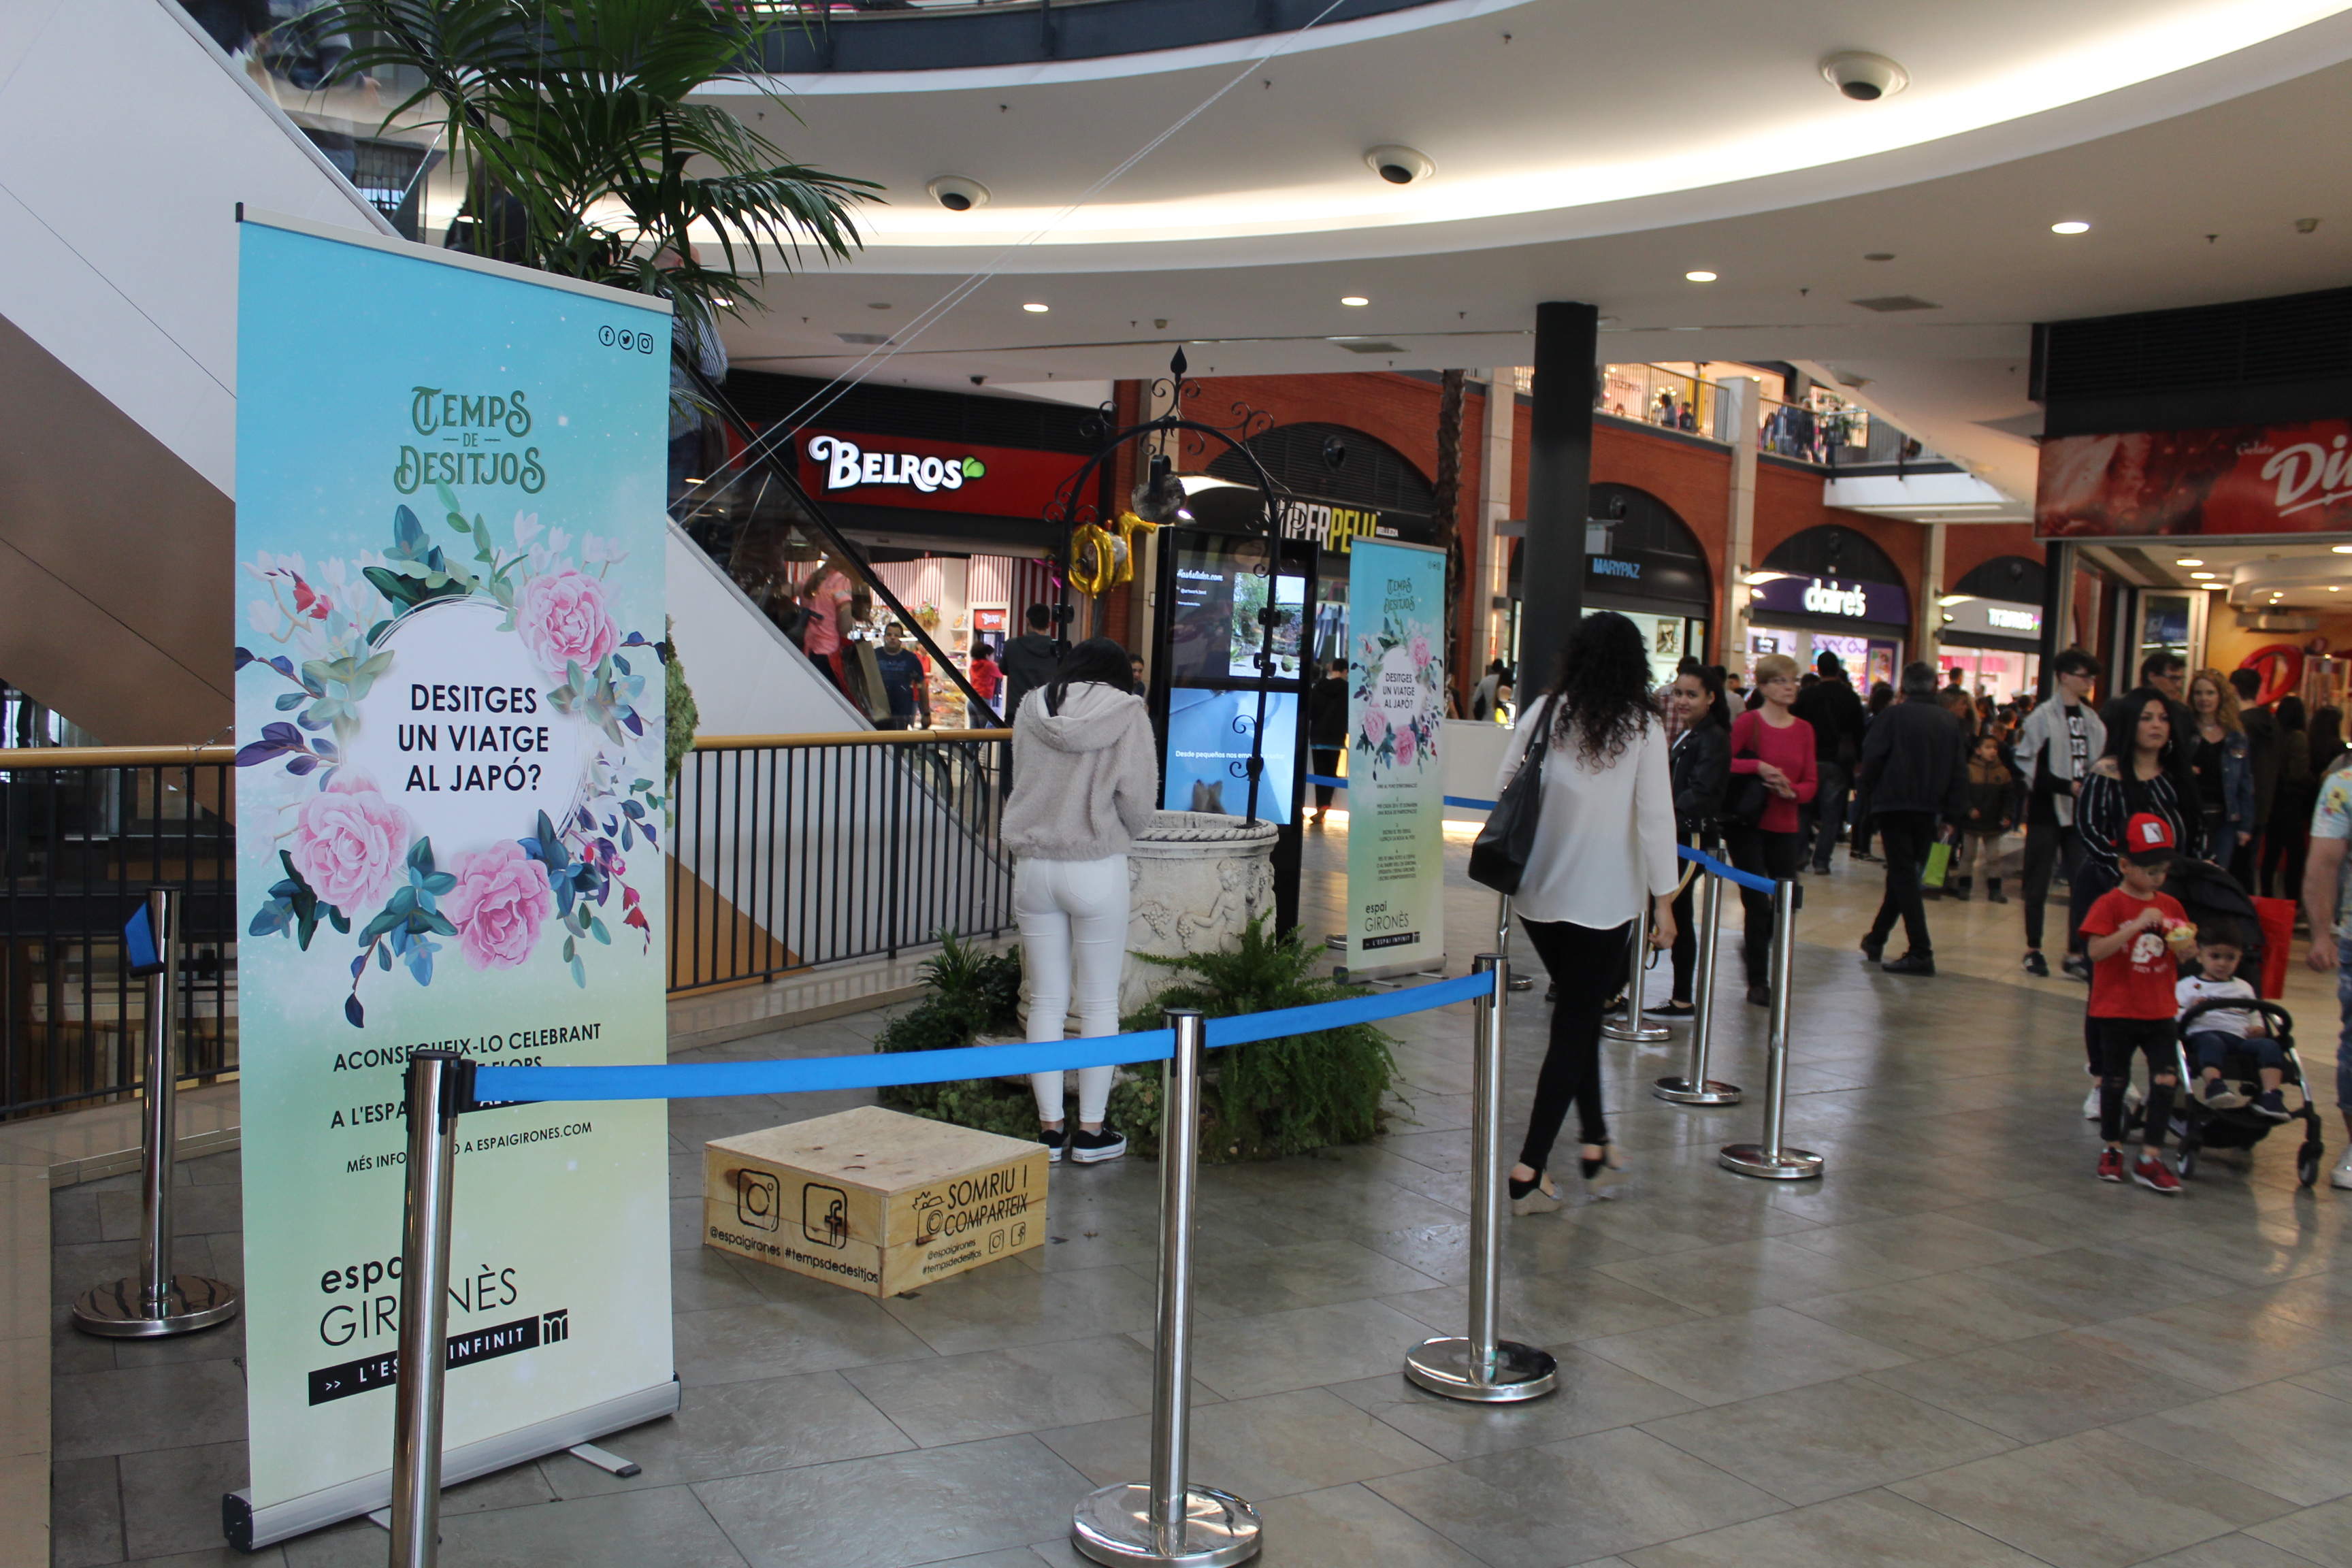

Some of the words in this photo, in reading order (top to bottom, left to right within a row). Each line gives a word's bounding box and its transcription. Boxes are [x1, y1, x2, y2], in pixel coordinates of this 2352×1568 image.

[412, 386, 532, 438] TEMPS
[463, 432, 478, 447] DE
[393, 445, 546, 495] DESITJOS
[808, 436, 963, 492] BELROS
[1593, 557, 1640, 579] MARYPAZ
[1387, 578, 1412, 595] TEMPS
[1803, 578, 1866, 617] claire's
[1384, 596, 1415, 613] DESITJOS
[1386, 673, 1412, 683] DESITGES
[411, 684, 537, 714] DESITGES
[1383, 686, 1392, 696] UN
[1394, 687, 1415, 697] VIATGE
[1384, 699, 1392, 708] AL
[1393, 698, 1414, 709] JAPÓ?
[399, 724, 436, 752] UN
[447, 725, 549, 753] VIATGE
[1196, 751, 1225, 760] pequeños
[405, 765, 440, 792] AL
[449, 757, 542, 792] JAPÓ?
[1366, 900, 1387, 915] espai
[1365, 911, 1409, 932] GIRONÈS
[509, 1023, 601, 1049] CELEBRANT
[331, 1111, 345, 1129] A
[346, 1155, 372, 1173] MÉS
[464, 1141, 473, 1153] A
[477, 1122, 592, 1151] ESPAIGIRONES.COM
[947, 1167, 1015, 1209] SOMRIU
[1024, 1164, 1027, 1188] I
[945, 1192, 1028, 1237] COMPARTEIX
[710, 1226, 781, 1257] @espaigirones
[785, 1247, 879, 1284] #tempsdedesitjos
[922, 1250, 982, 1275] #tempsdedesitjos
[928, 1239, 976, 1260] @espaigirones
[320, 1264, 517, 1346] GIRNÈS
[450, 1327, 524, 1360] INFINIT
